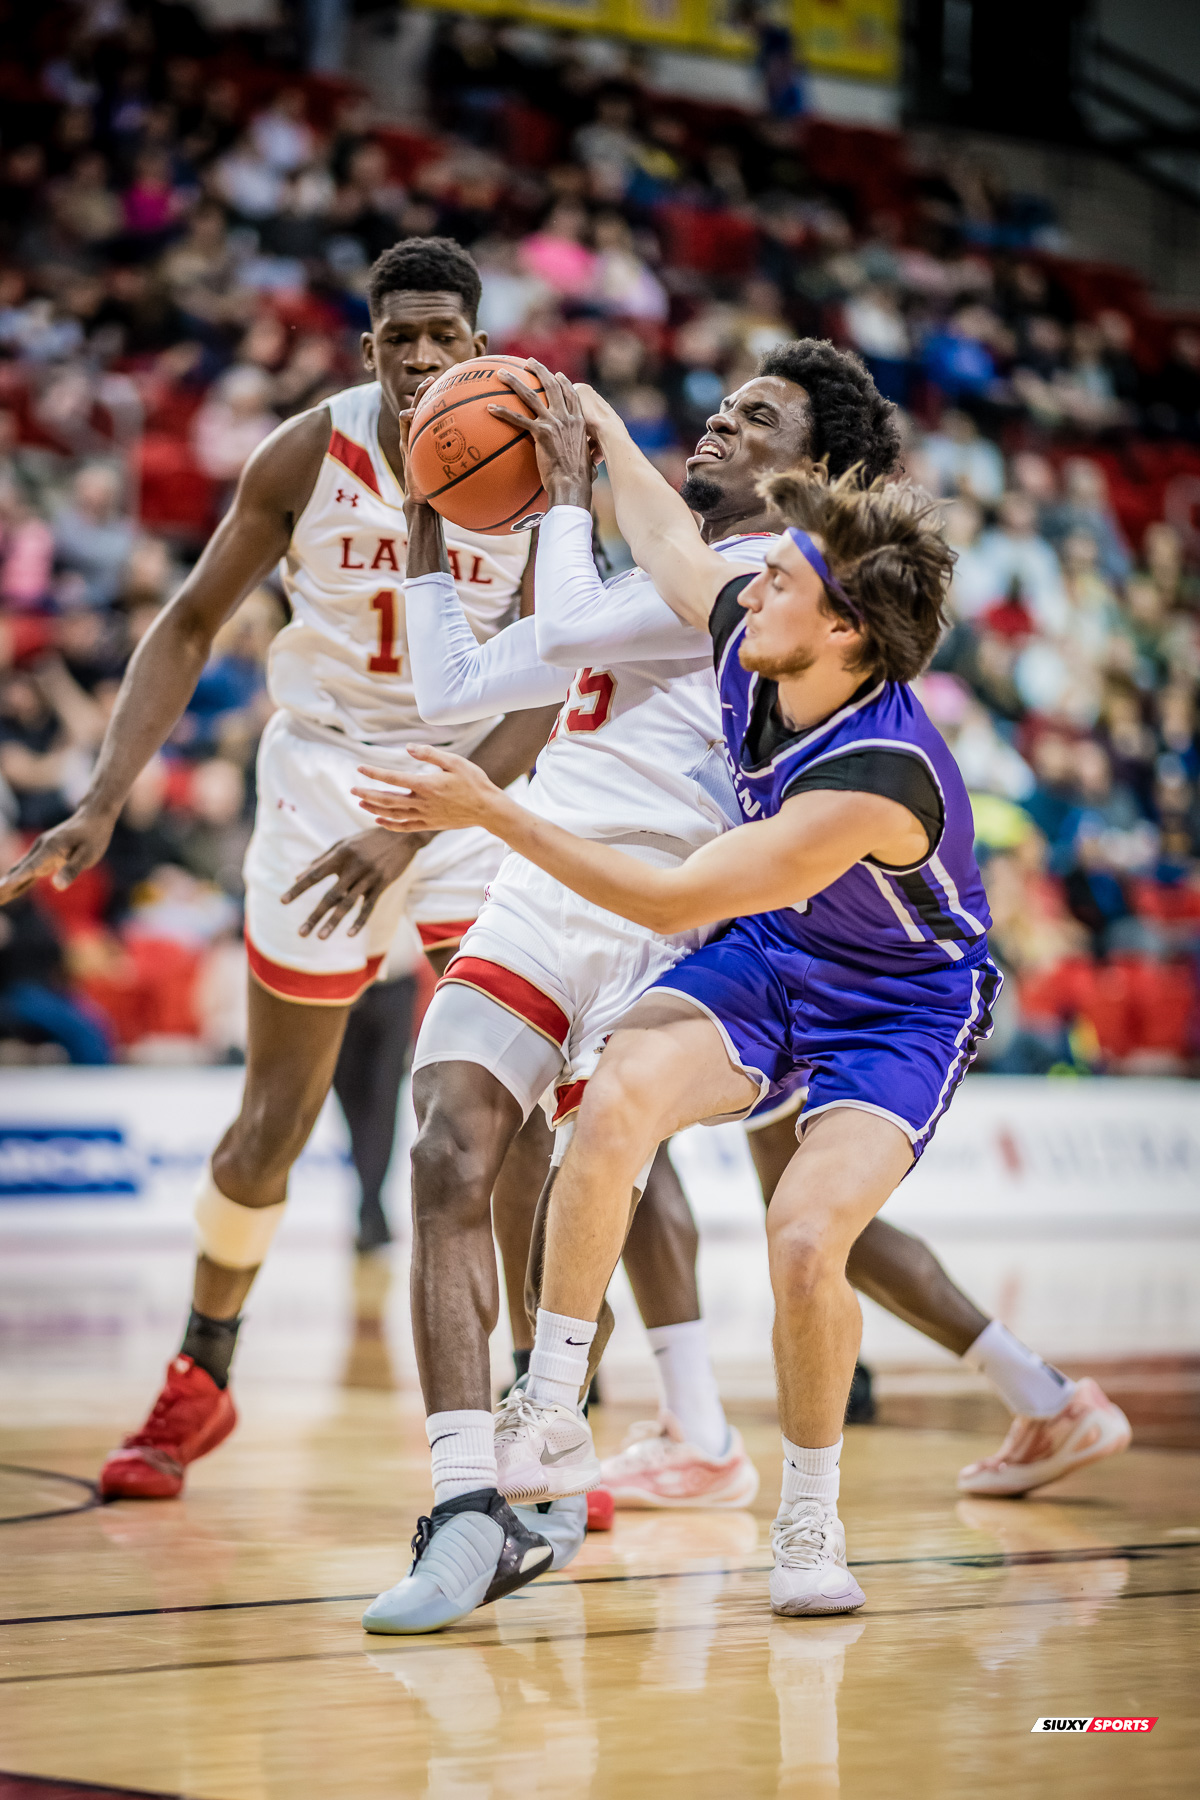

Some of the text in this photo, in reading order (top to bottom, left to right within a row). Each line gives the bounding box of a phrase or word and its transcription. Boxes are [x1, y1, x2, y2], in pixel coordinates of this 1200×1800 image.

[339, 537, 493, 585] LAAL
[366, 587, 403, 676] 1
[550, 667, 618, 744] 5
